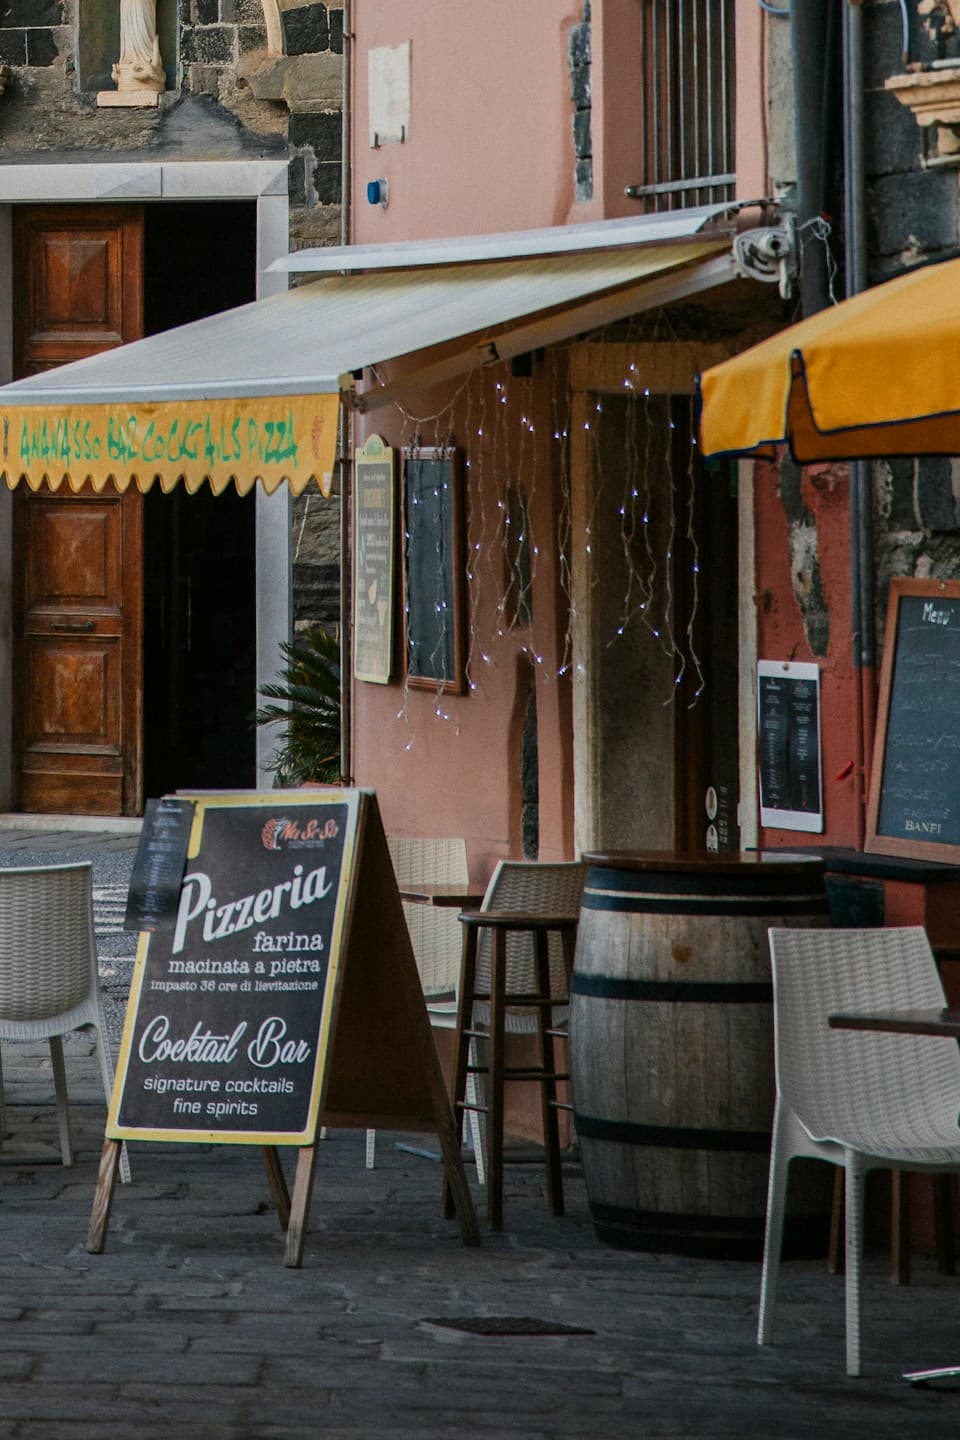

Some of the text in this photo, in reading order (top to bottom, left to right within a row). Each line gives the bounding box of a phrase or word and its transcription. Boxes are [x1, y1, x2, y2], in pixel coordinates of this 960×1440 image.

[107, 415, 138, 468] BAR
[904, 819, 943, 835] BANFI
[172, 864, 332, 954] Pizzeria
[252, 931, 324, 952] farina
[167, 956, 321, 977] macinata a pietra
[150, 978, 319, 993] impasto 36 ore di lievitazione
[138, 1014, 311, 1068] Cocktail Bar
[143, 1074, 295, 1096] signature cocktails
[173, 1097, 259, 1120] fine spirits
